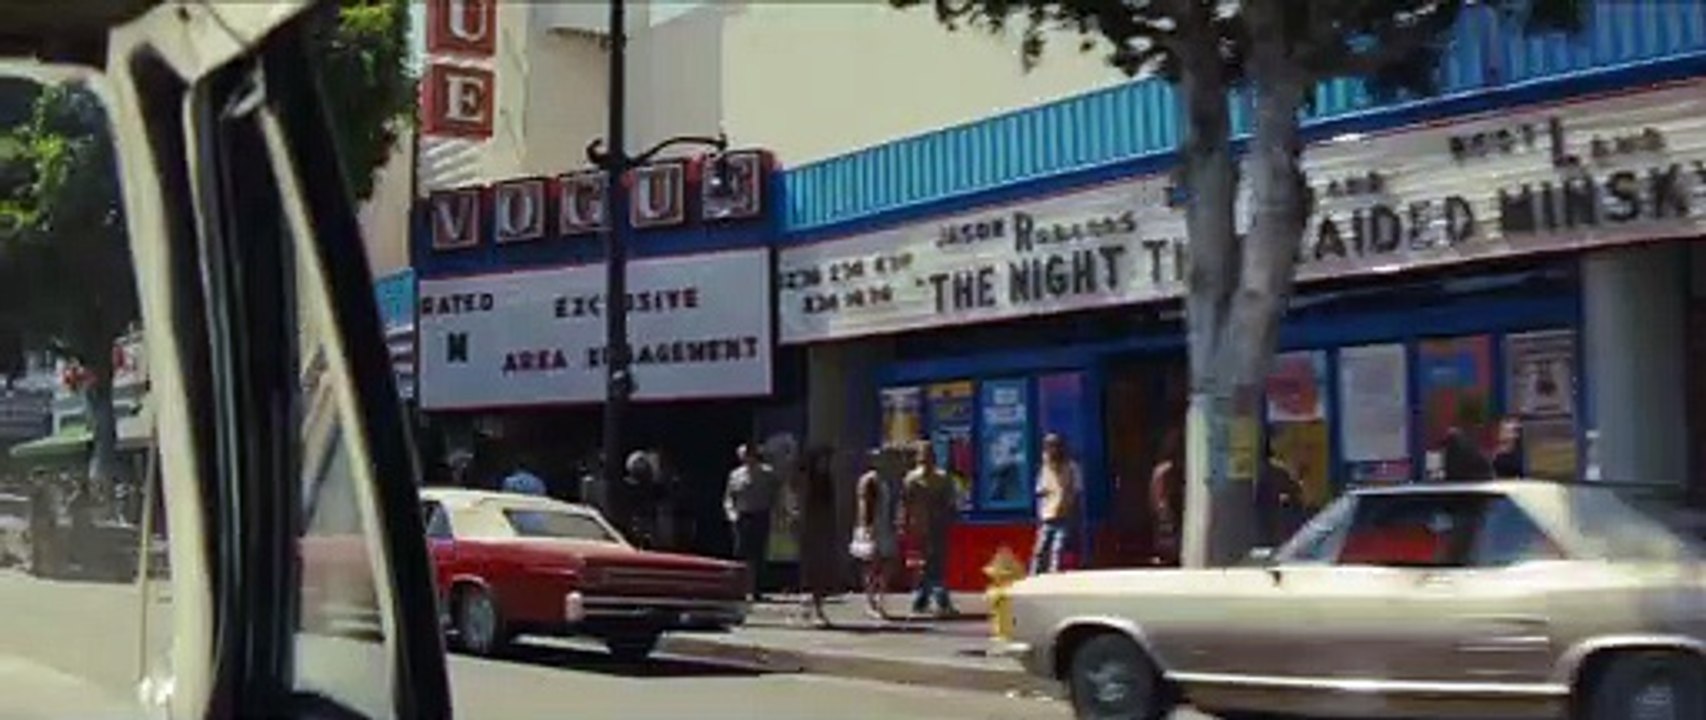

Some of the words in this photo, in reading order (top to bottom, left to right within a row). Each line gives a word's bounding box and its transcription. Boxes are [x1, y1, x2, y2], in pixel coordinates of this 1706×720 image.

[1009, 245, 1124, 302] NIGHT
[420, 293, 495, 315] RATED
[502, 349, 569, 372] AREA
